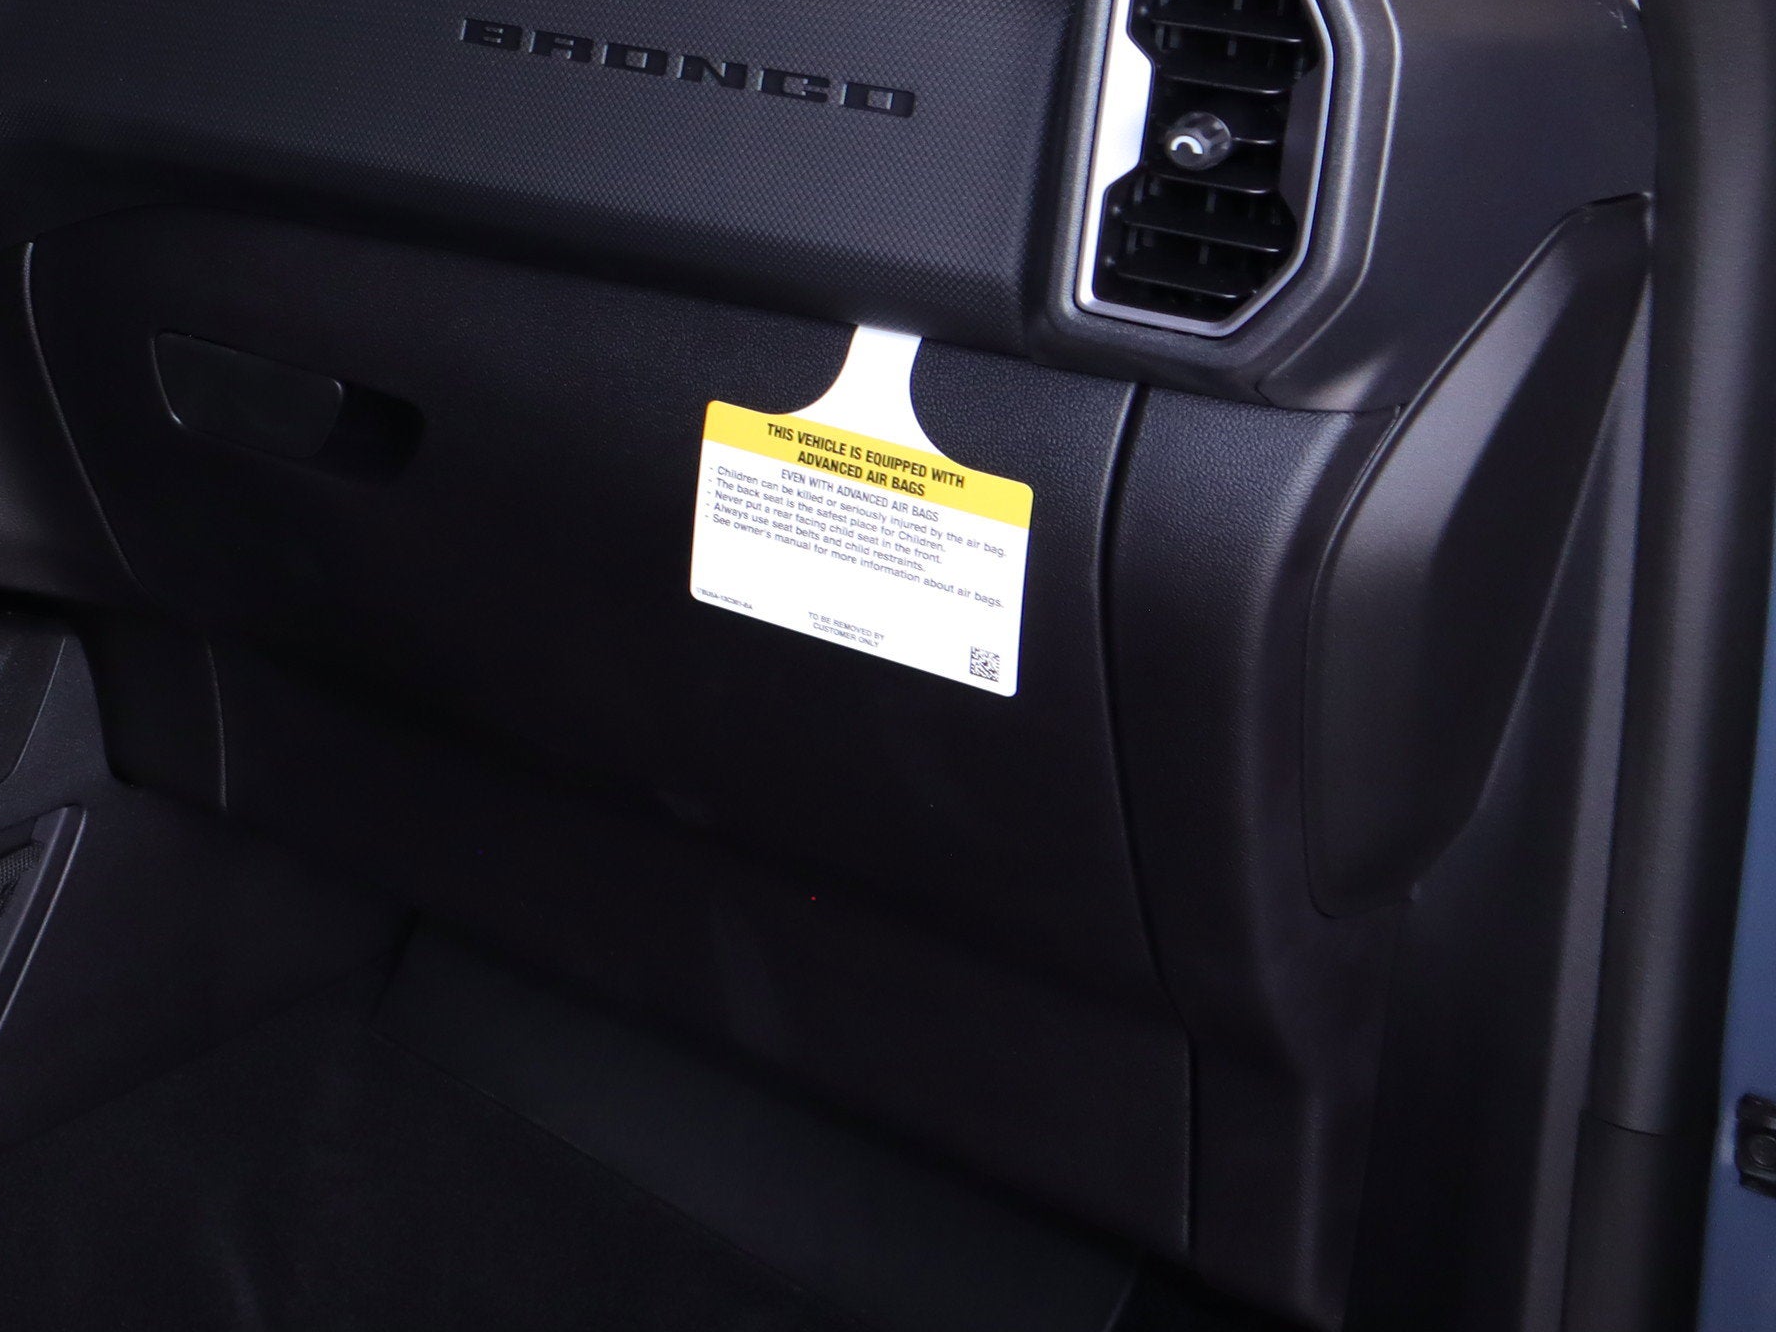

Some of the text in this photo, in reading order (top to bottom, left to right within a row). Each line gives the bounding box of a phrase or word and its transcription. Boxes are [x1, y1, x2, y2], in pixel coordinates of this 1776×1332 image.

[459, 16, 916, 119] BRONCO
[768, 423, 965, 486] THIS VEHICLE IS EQUIPPED WITH
[798, 451, 925, 496] ADVANCED AIR BAGS
[714, 489, 942, 564] Never put a rear facing child seat in the front.
[716, 477, 945, 551] The back seat is the safest place for Children.
[717, 465, 1005, 558] Children can be killed or seriously injured by the air bag.
[781, 468, 940, 523] EVEN WITH ADVANCED AIR BAGS
[712, 513, 1003, 608] See owner's manual for more information about air bags.
[713, 502, 925, 572] Always use seat belts and child restraints.
[808, 611, 886, 639] TO BE REMOVED BY
[813, 622, 880, 647] CUSTOMER ONLY
